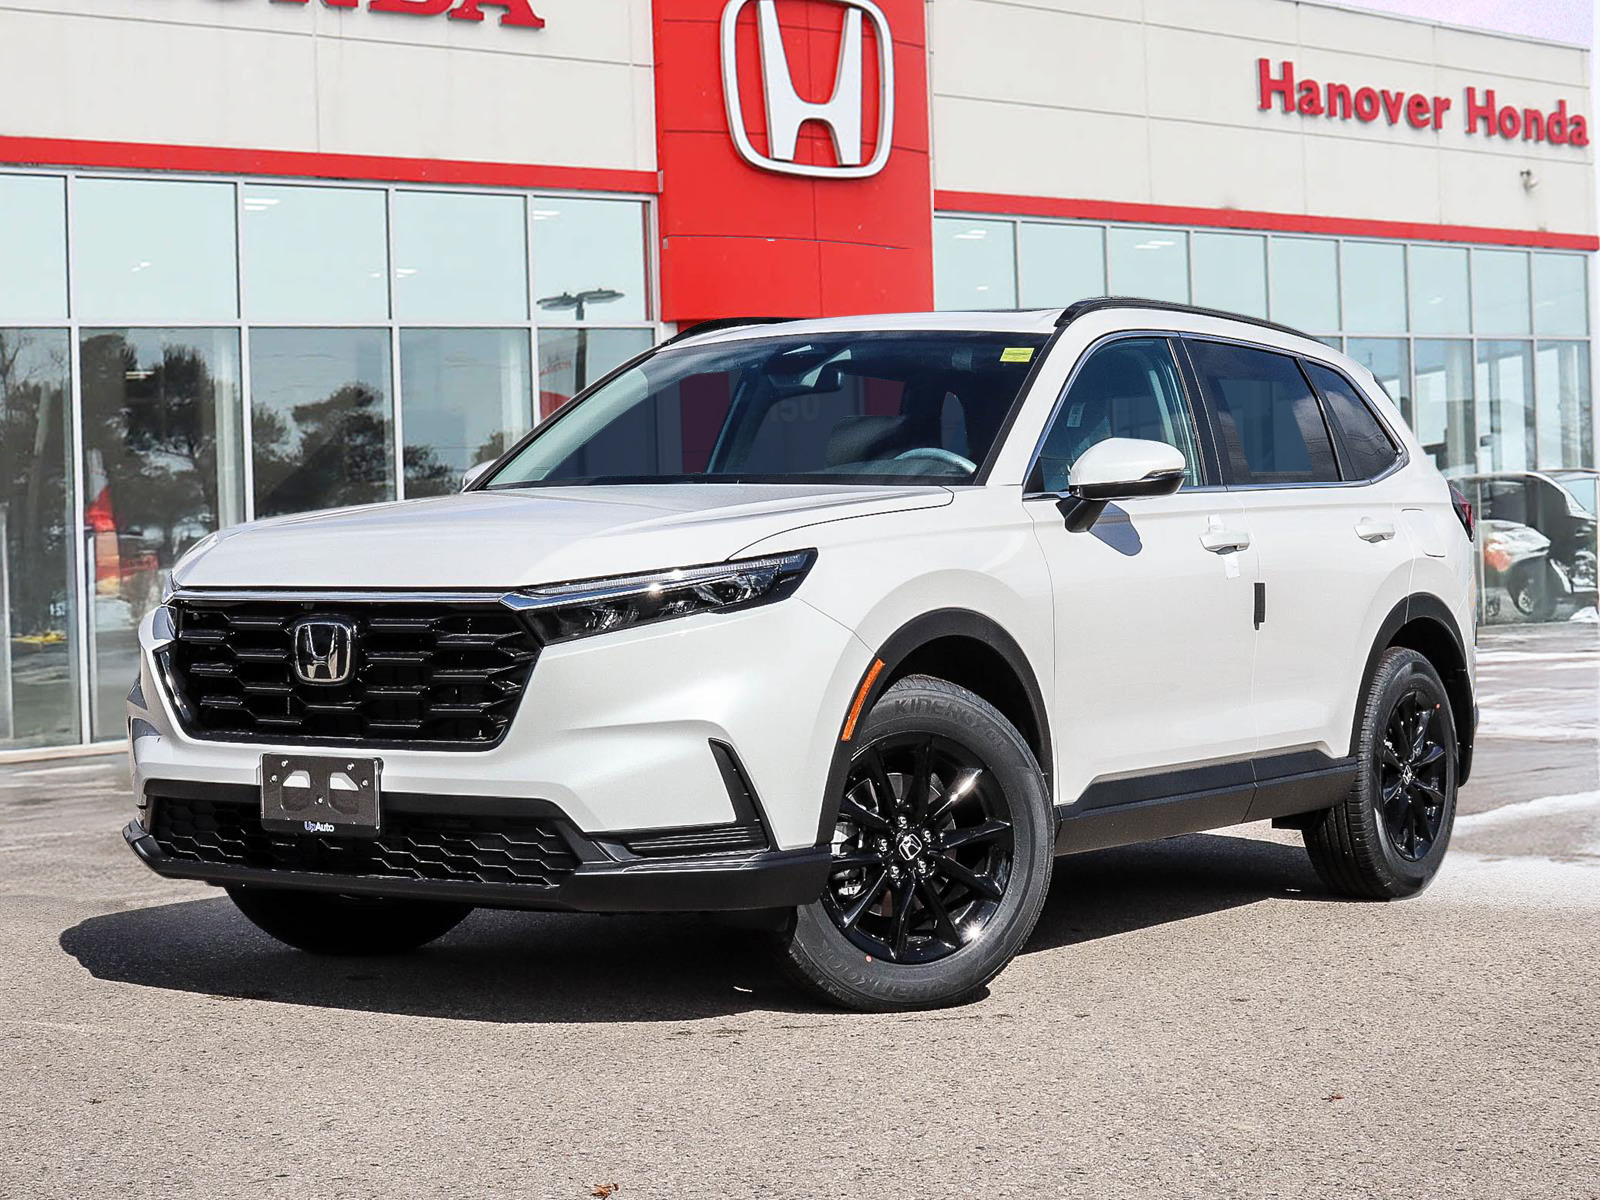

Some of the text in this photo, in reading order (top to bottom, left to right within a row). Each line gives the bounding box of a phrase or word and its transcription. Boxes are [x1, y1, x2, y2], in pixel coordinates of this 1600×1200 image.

[1257, 57, 1590, 148] Hanover Honda
[304, 821, 335, 832] UpAuto
